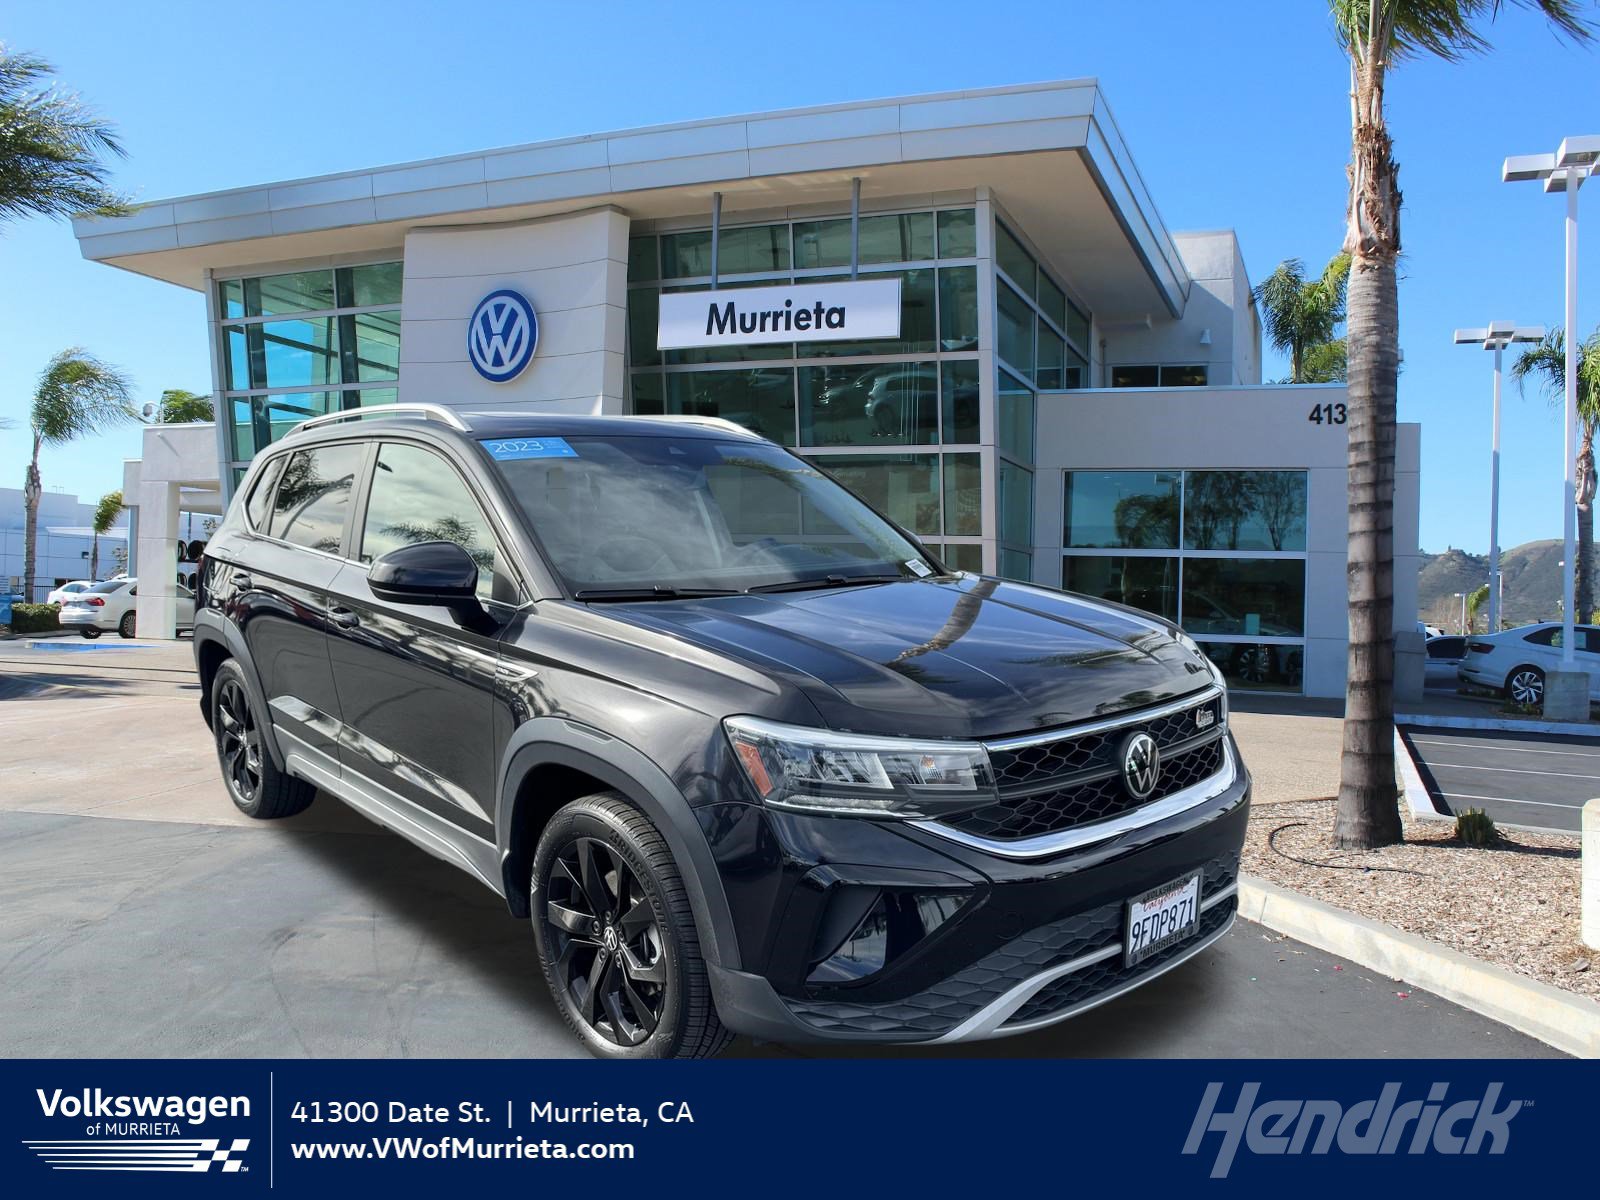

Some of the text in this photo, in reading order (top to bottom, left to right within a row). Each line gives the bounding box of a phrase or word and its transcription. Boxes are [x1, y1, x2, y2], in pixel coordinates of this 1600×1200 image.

[705, 299, 846, 336] Murrieta
[1308, 403, 1347, 425] 413
[489, 440, 544, 453] 2023
[1131, 896, 1194, 954] 9FDP871
